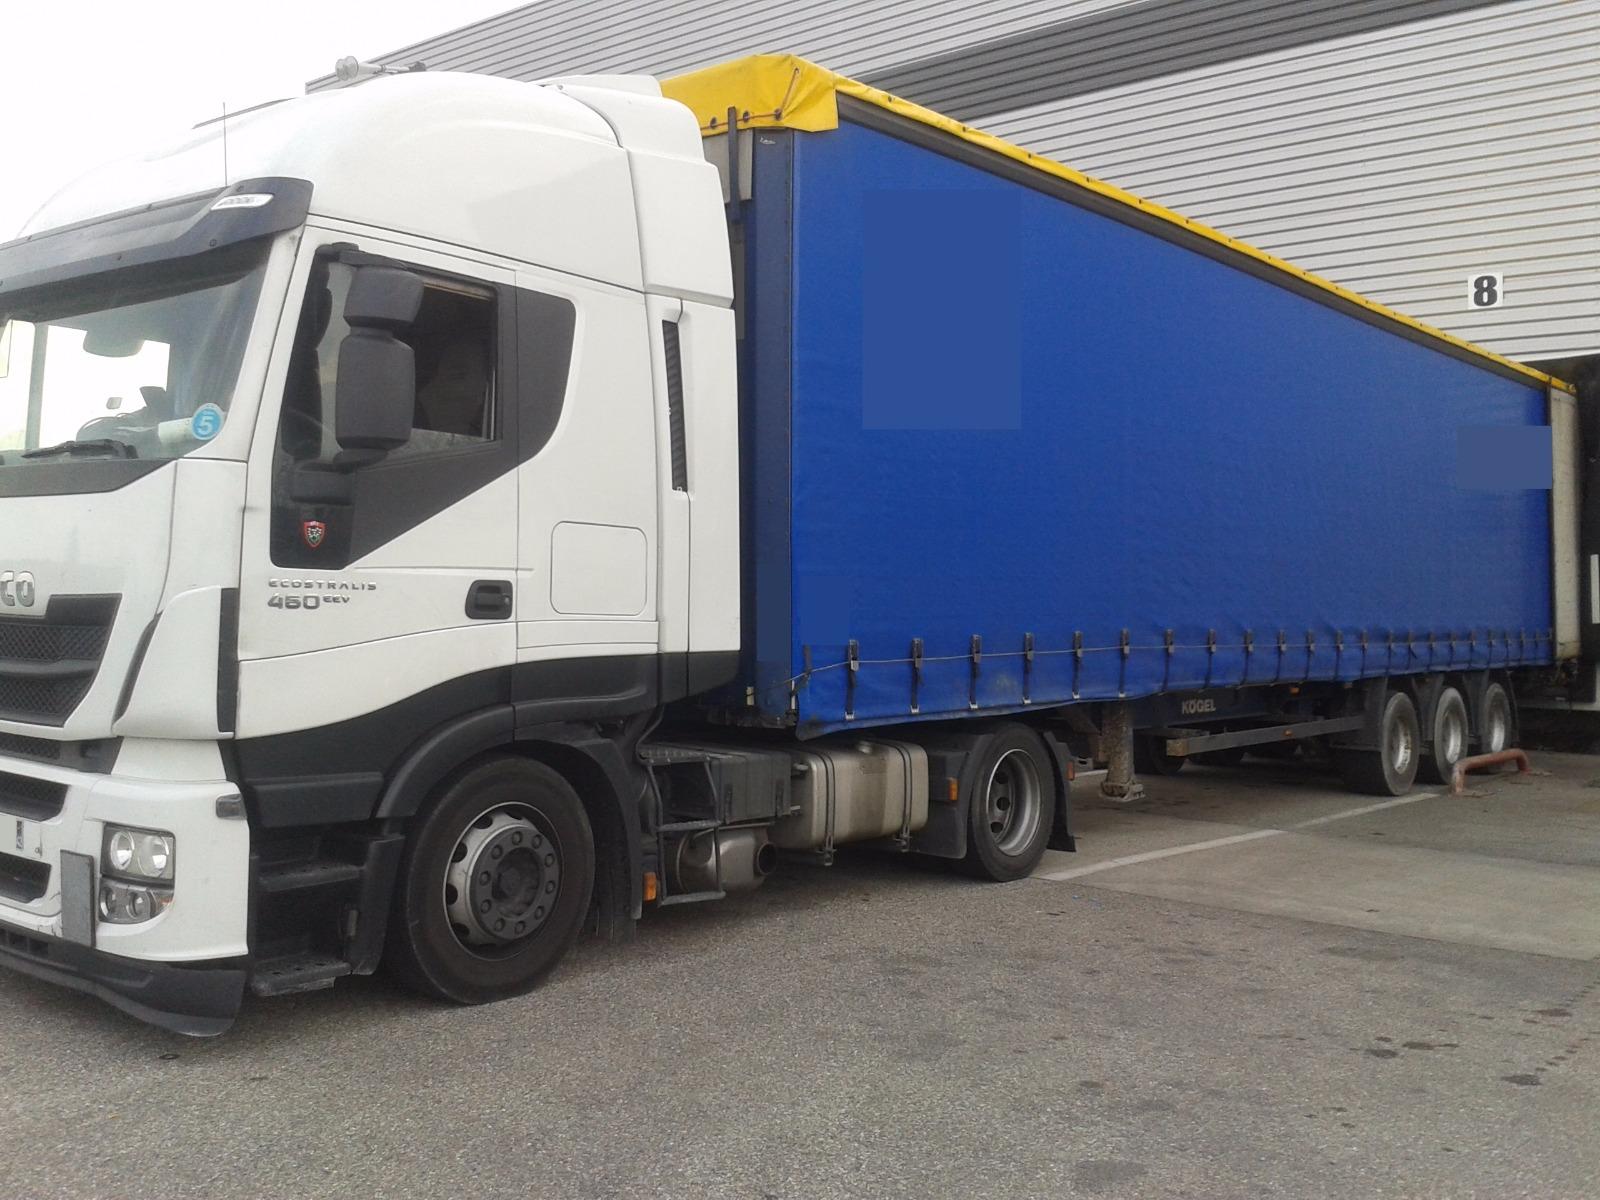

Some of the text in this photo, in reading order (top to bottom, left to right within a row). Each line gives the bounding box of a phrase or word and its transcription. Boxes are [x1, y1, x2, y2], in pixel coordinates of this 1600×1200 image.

[1473, 275, 1498, 307] 8
[196, 414, 214, 435] 5
[268, 578, 377, 591] ECOSTRALIS
[267, 593, 351, 609] 460 EEV
[1182, 698, 1217, 715] KÖGEL
